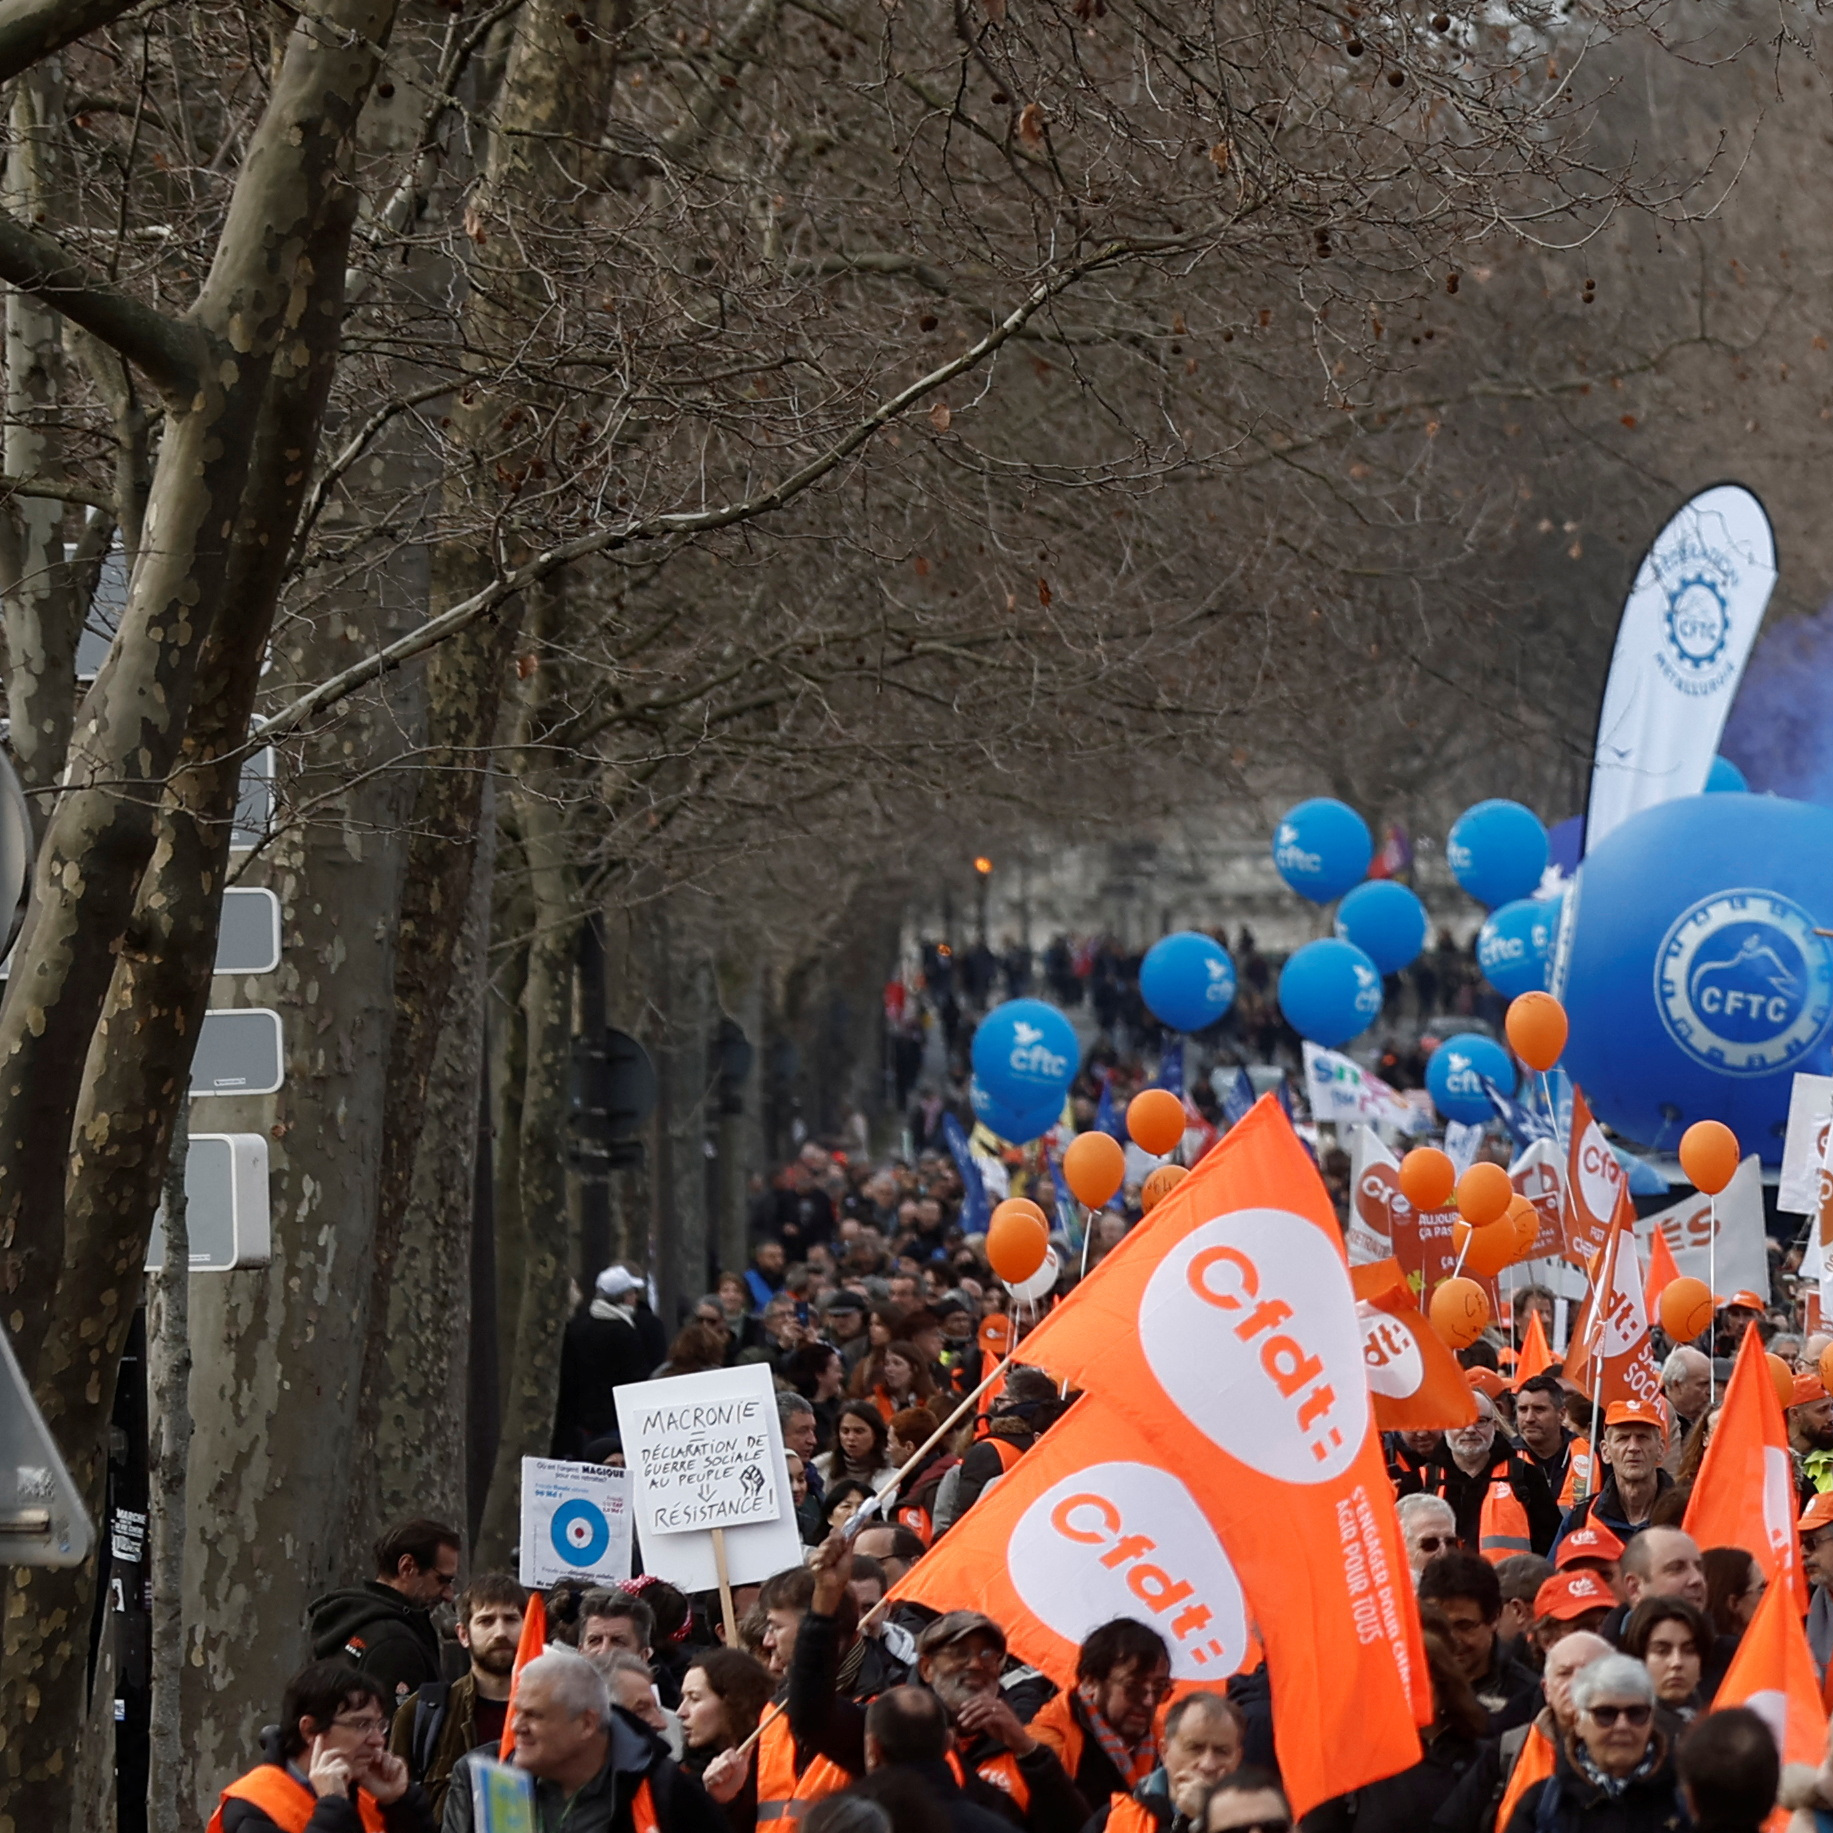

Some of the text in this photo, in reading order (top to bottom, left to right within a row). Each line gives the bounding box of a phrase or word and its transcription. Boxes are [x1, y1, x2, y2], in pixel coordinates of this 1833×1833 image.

[1700, 986, 1788, 1023] CFTC
[1418, 1211, 1460, 1225] AUJOUR
[1186, 1244, 1346, 1463] Cfdt:
[642, 1402, 760, 1435] MACRONIE
[747, 1434, 768, 1448] DE
[582, 1465, 625, 1478] MAGIQUE
[644, 1459, 697, 1478] GUERRE
[649, 1466, 736, 1490] AU PEUPLE
[654, 1487, 774, 1529] RÉSISTANCE !
[1351, 1484, 1390, 1588] S'ENGAGER
[1050, 1490, 1226, 1665] Cfdt:
[1335, 1498, 1385, 1646] AGIR POUR TOUS
